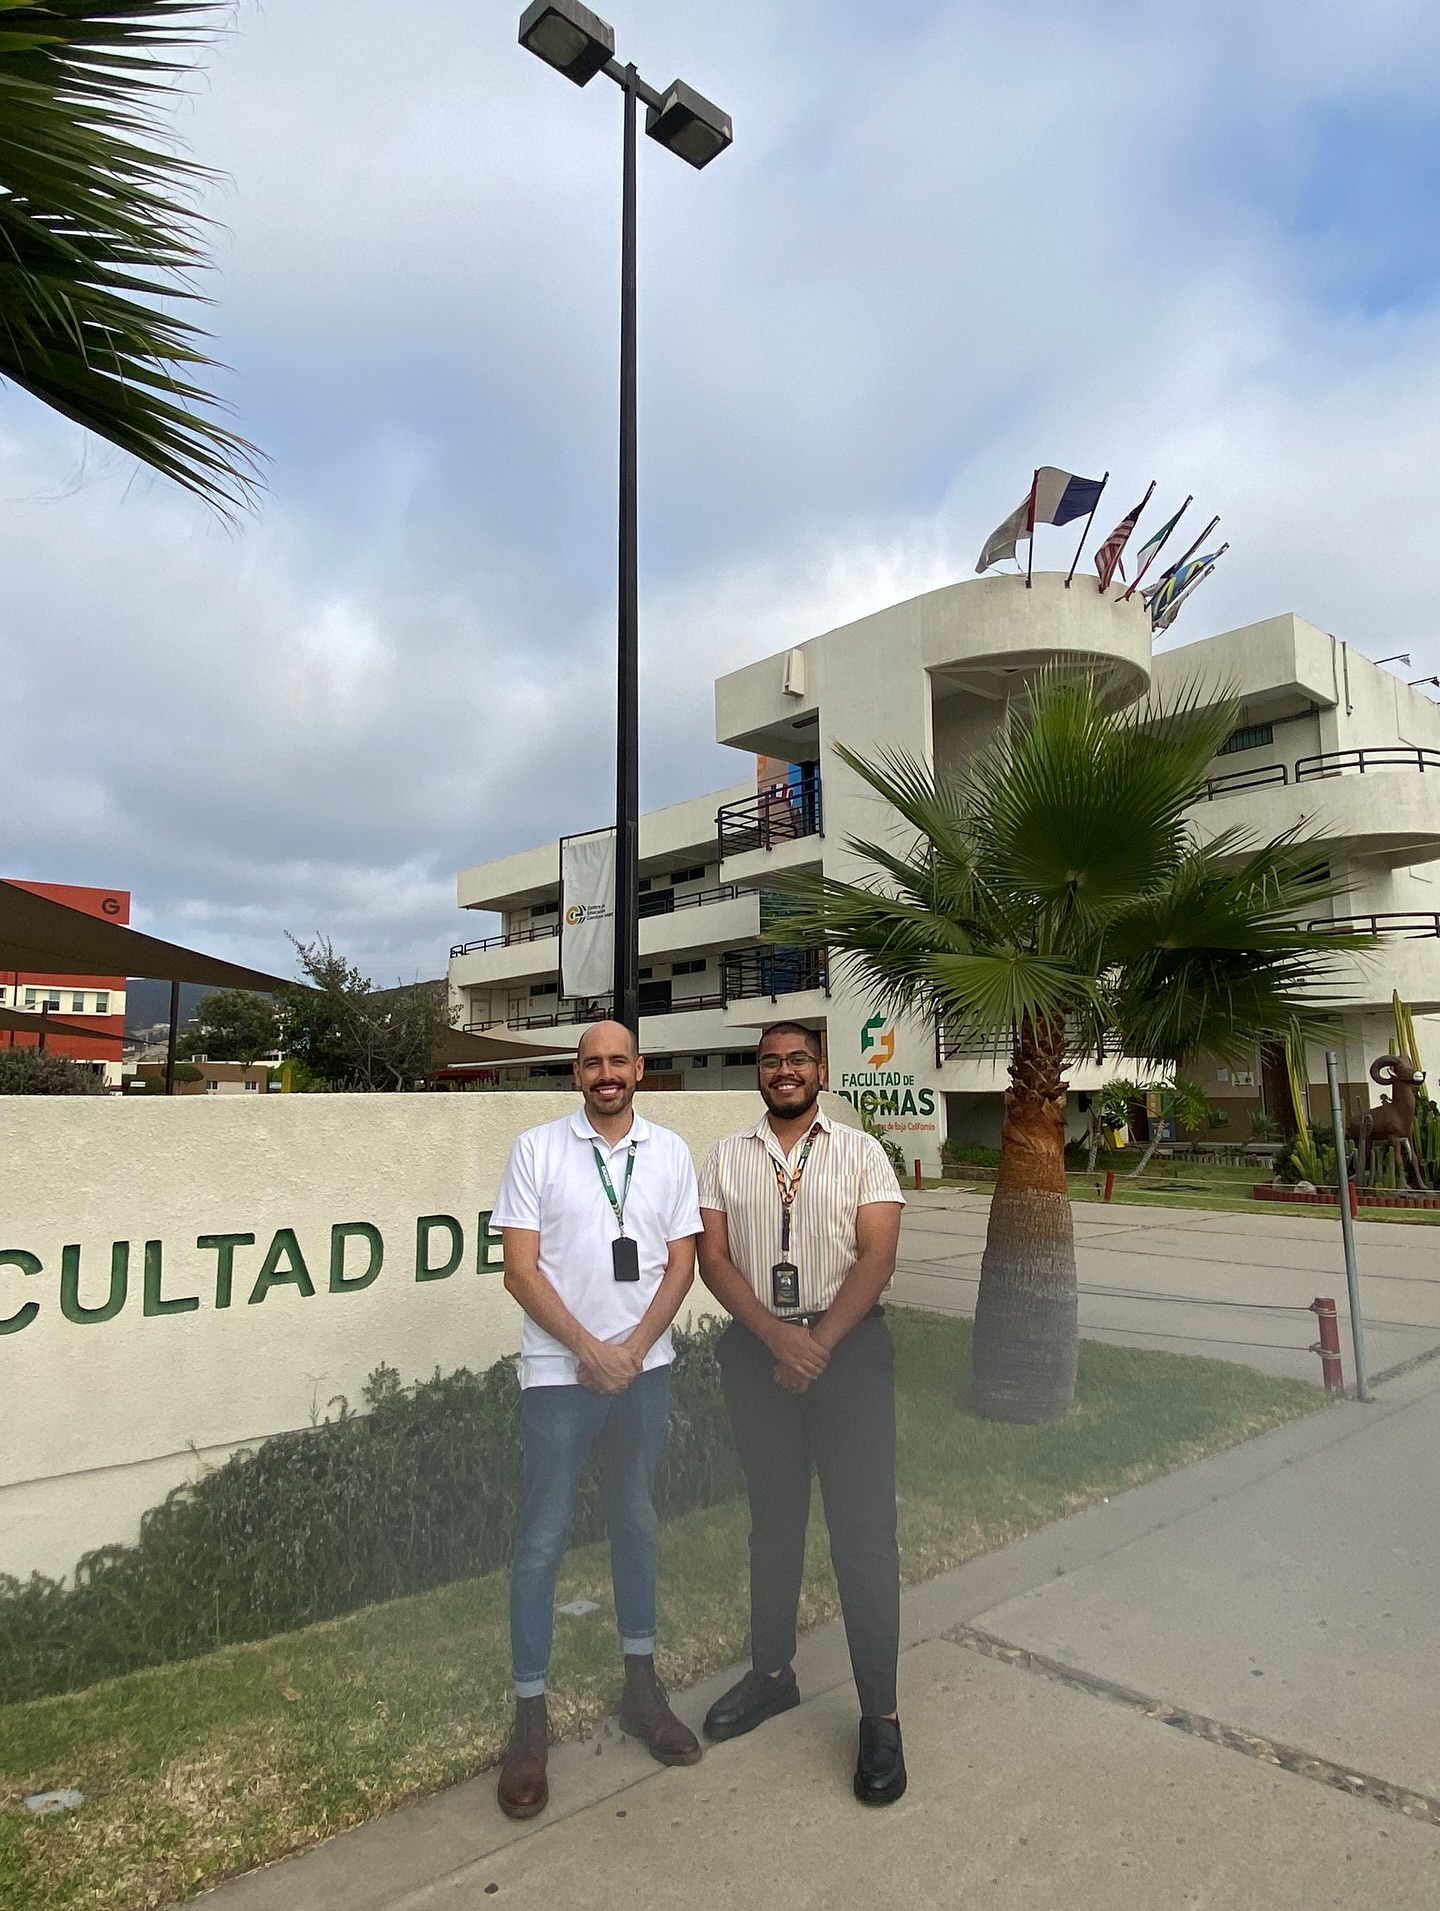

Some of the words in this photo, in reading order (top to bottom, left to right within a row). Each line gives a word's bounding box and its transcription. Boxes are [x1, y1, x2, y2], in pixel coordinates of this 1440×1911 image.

[101, 897, 121, 916] G
[842, 1072, 901, 1087] FACULTAD
[903, 1075, 915, 1086] DE
[833, 1088, 935, 1116] IOMAS
[888, 1121, 894, 1131] de
[894, 1121, 906, 1133] Baja
[907, 1121, 935, 1131] California
[415, 1210, 504, 1282] DE
